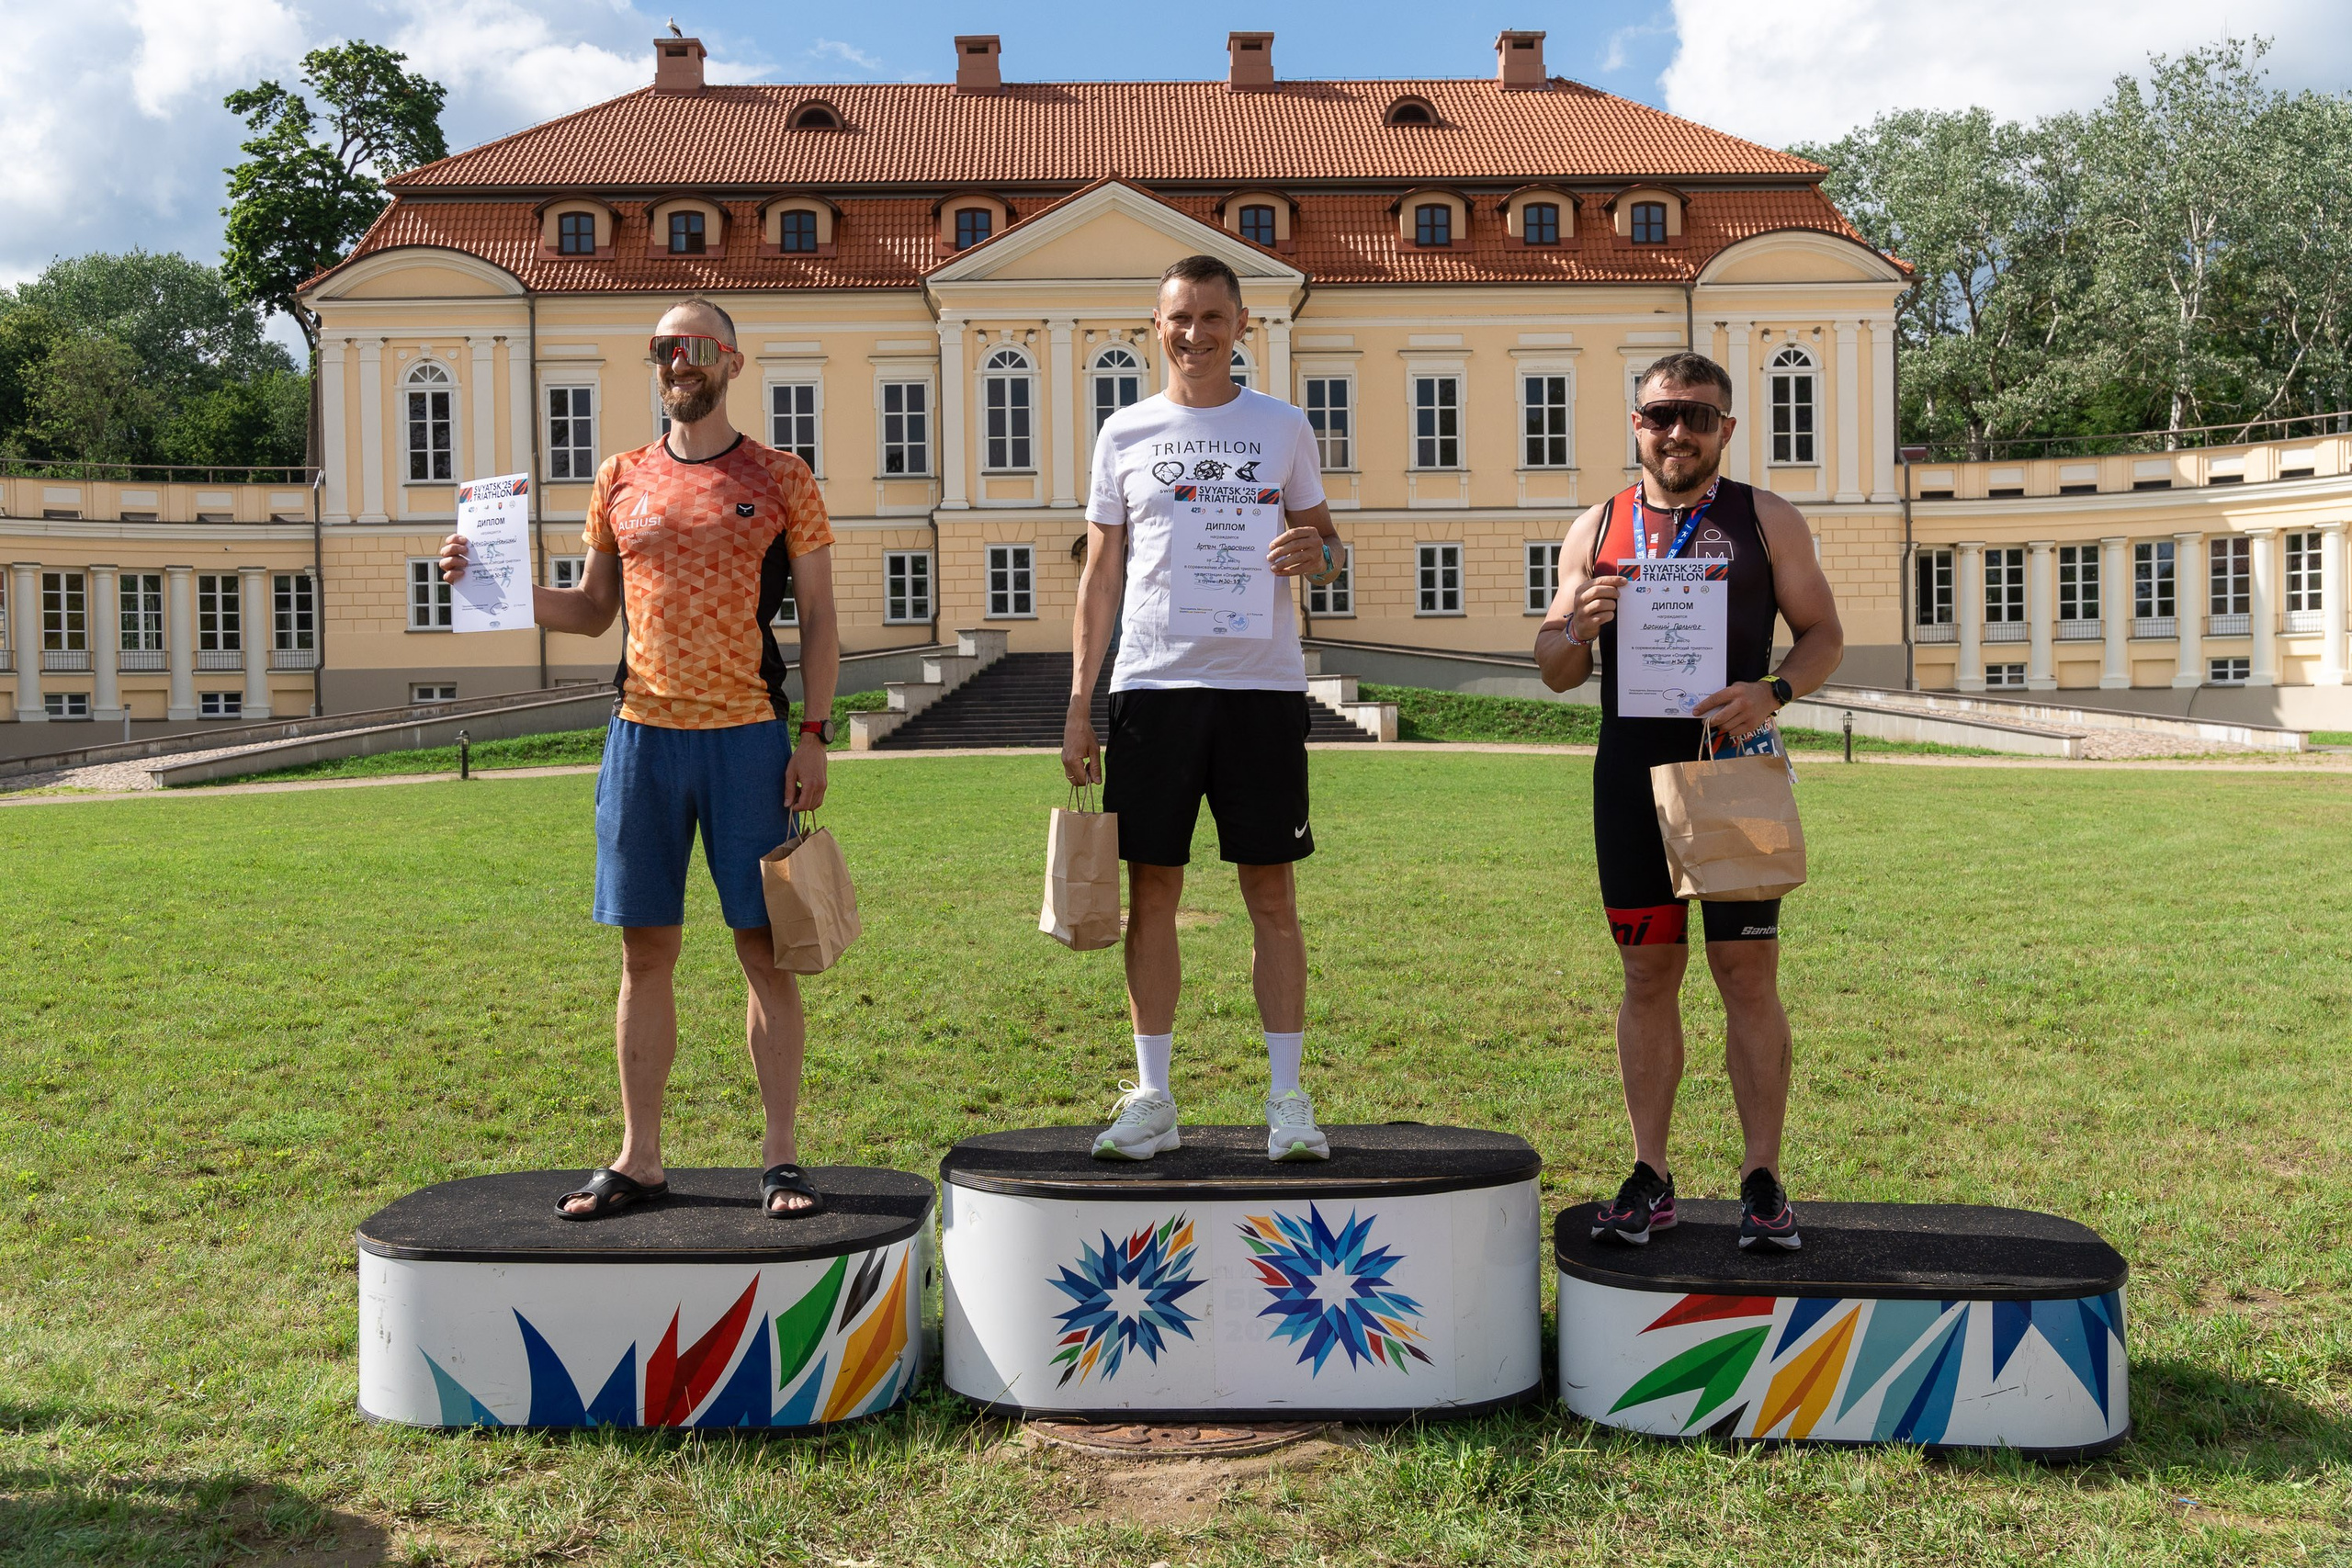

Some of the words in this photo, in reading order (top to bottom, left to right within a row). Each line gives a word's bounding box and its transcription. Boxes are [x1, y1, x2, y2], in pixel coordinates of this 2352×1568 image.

[1152, 440, 1261, 457] TRIATHLON
[473, 481, 502, 493] SVYATSK
[1199, 486, 1241, 496] SVYATSK
[473, 489, 513, 502] TRIATHLON
[1198, 494, 1258, 504] TRIATHLON
[477, 517, 505, 528] ДИПЛОМ
[618, 516, 662, 532] ALTIUS!
[1205, 522, 1246, 531] ДИПЛОМ
[1643, 564, 1689, 573] SVYATSK
[1643, 573, 1704, 581] TRIATHLON
[1651, 602, 1694, 611] ДИПЛОМ
